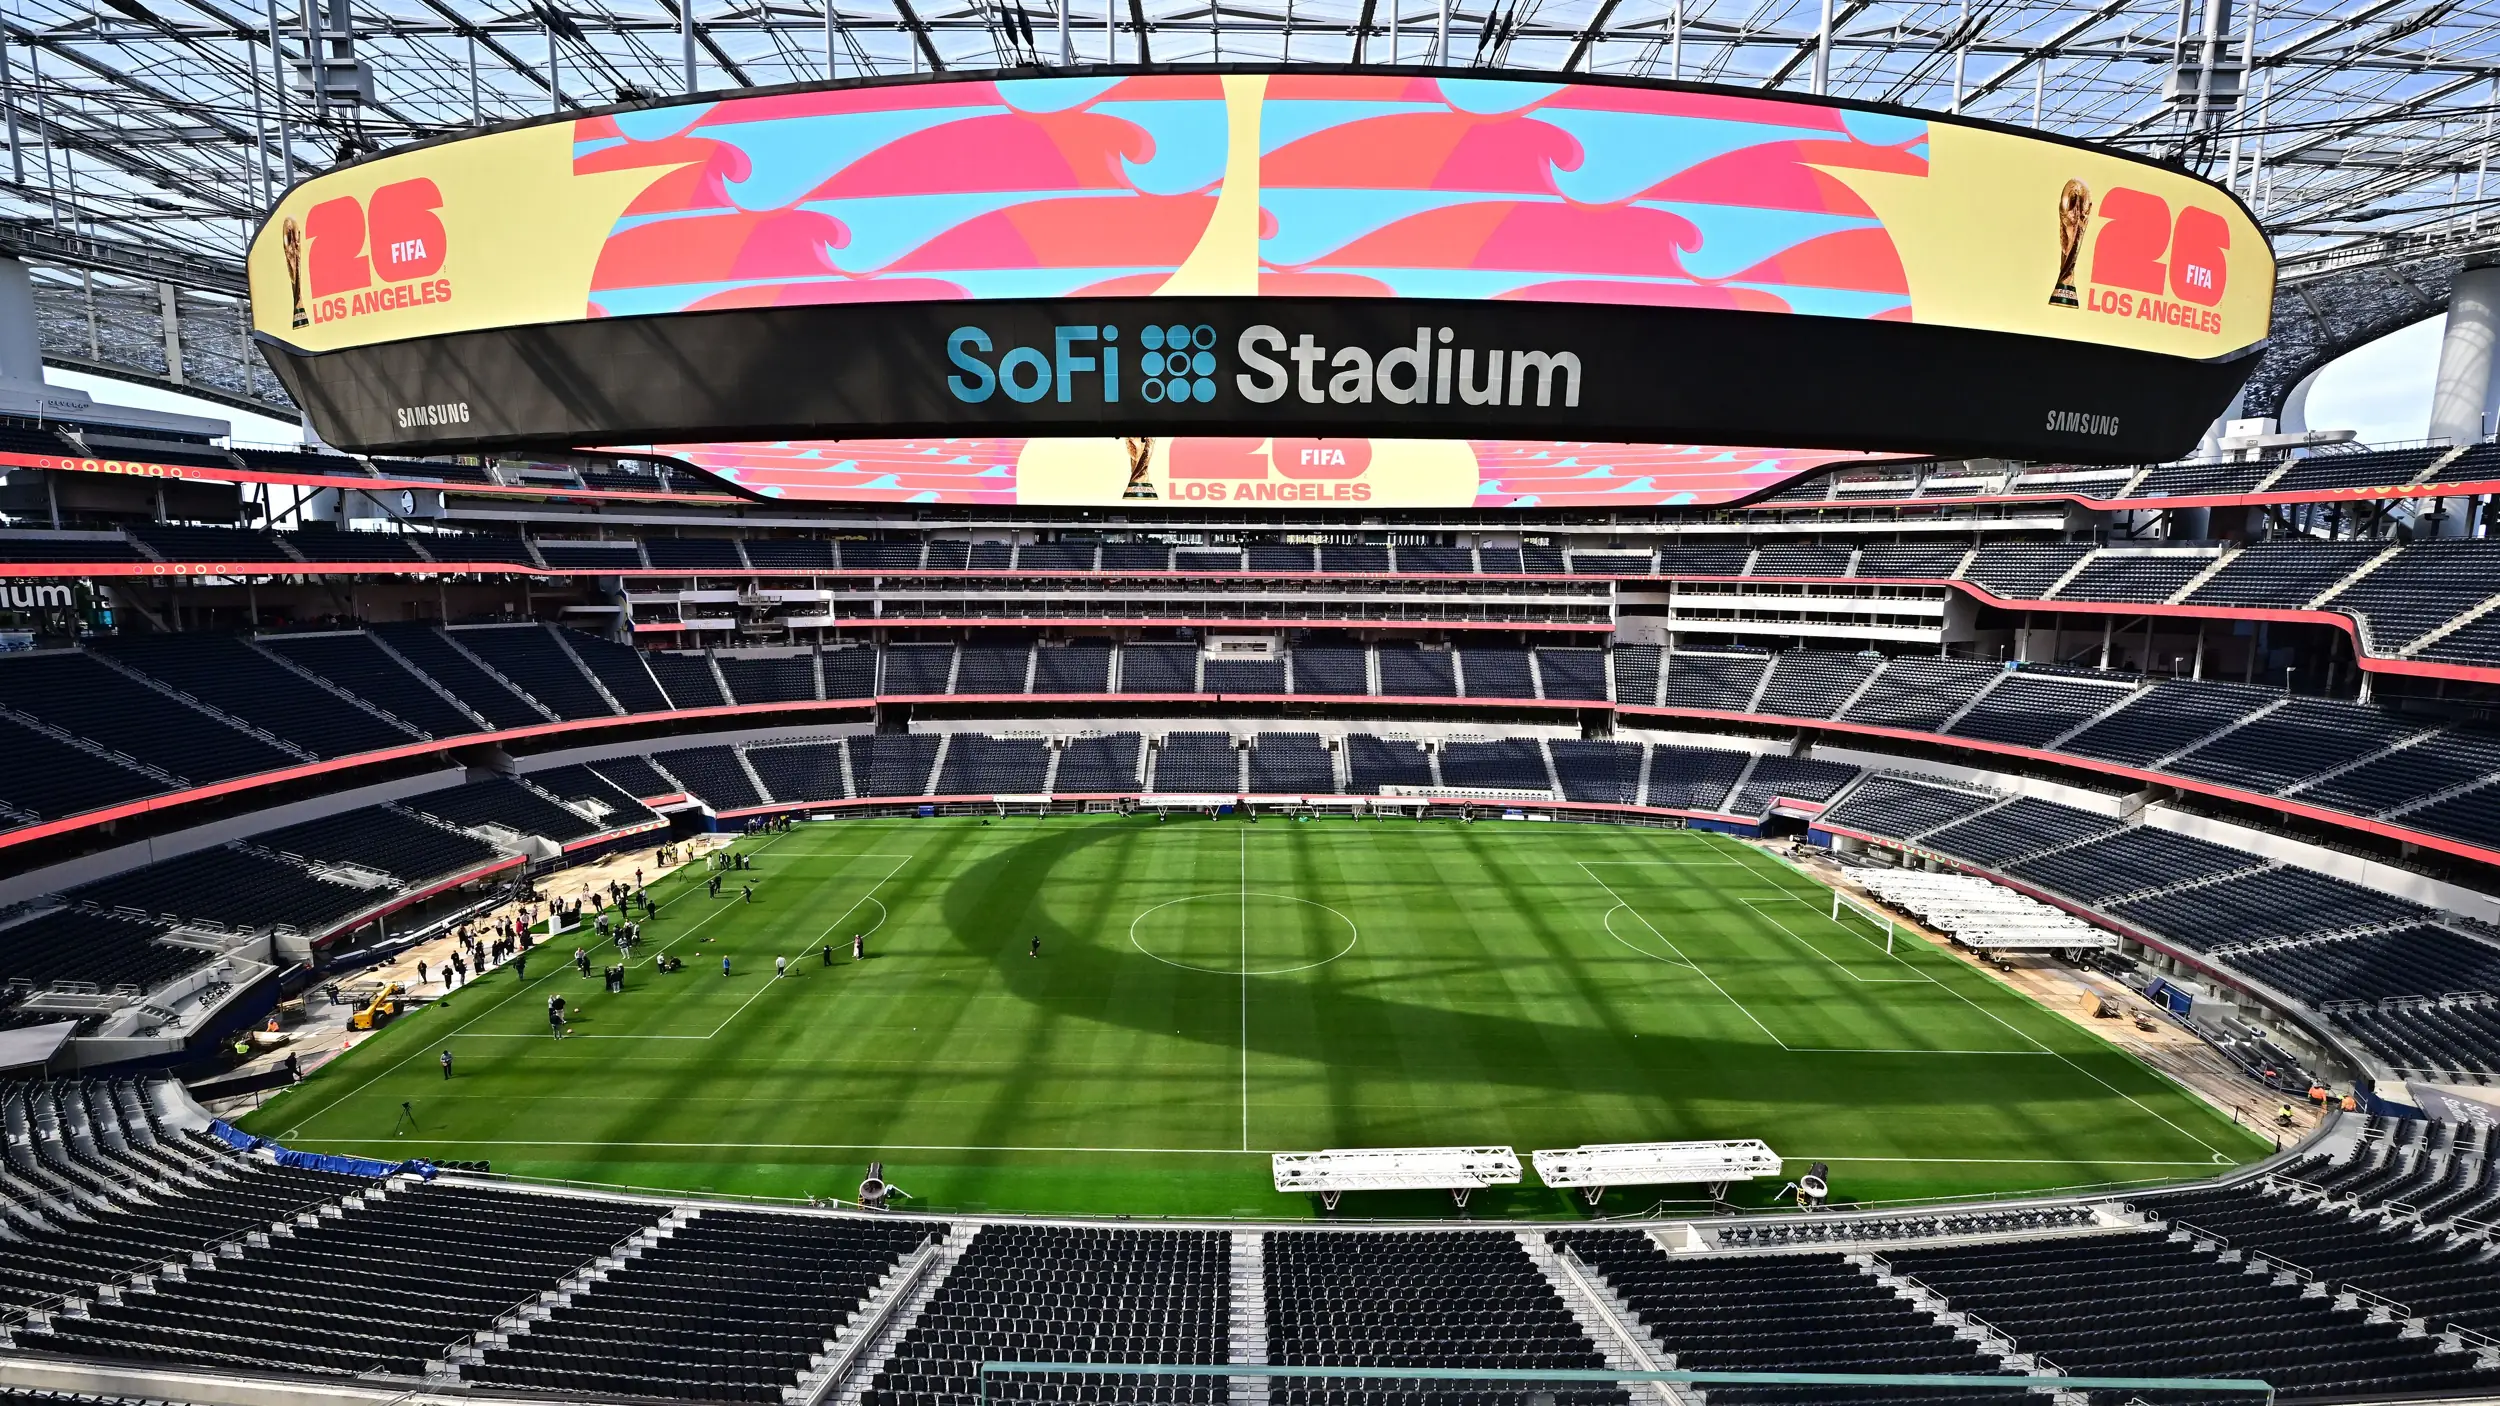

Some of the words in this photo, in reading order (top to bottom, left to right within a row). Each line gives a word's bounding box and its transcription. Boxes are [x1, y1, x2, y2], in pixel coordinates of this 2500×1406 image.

[305, 177, 447, 299] 26
[391, 238, 427, 264] FIFA
[2090, 186, 2231, 307] 26
[2186, 264, 2212, 289] FIFA
[313, 297, 347, 324] LOS
[351, 279, 452, 317] ANGELES
[2087, 288, 2133, 317] LOS
[2136, 298, 2222, 335] ANGELES
[947, 325, 1118, 403] SoFi
[1236, 324, 1582, 408] Stadium
[397, 402, 470, 428] SAMSUNG
[2046, 409, 2119, 436] SAMSUNG
[1300, 449, 1346, 465] FIFA
[1169, 482, 1227, 501] LOS
[1233, 482, 1371, 501] ANGELES
